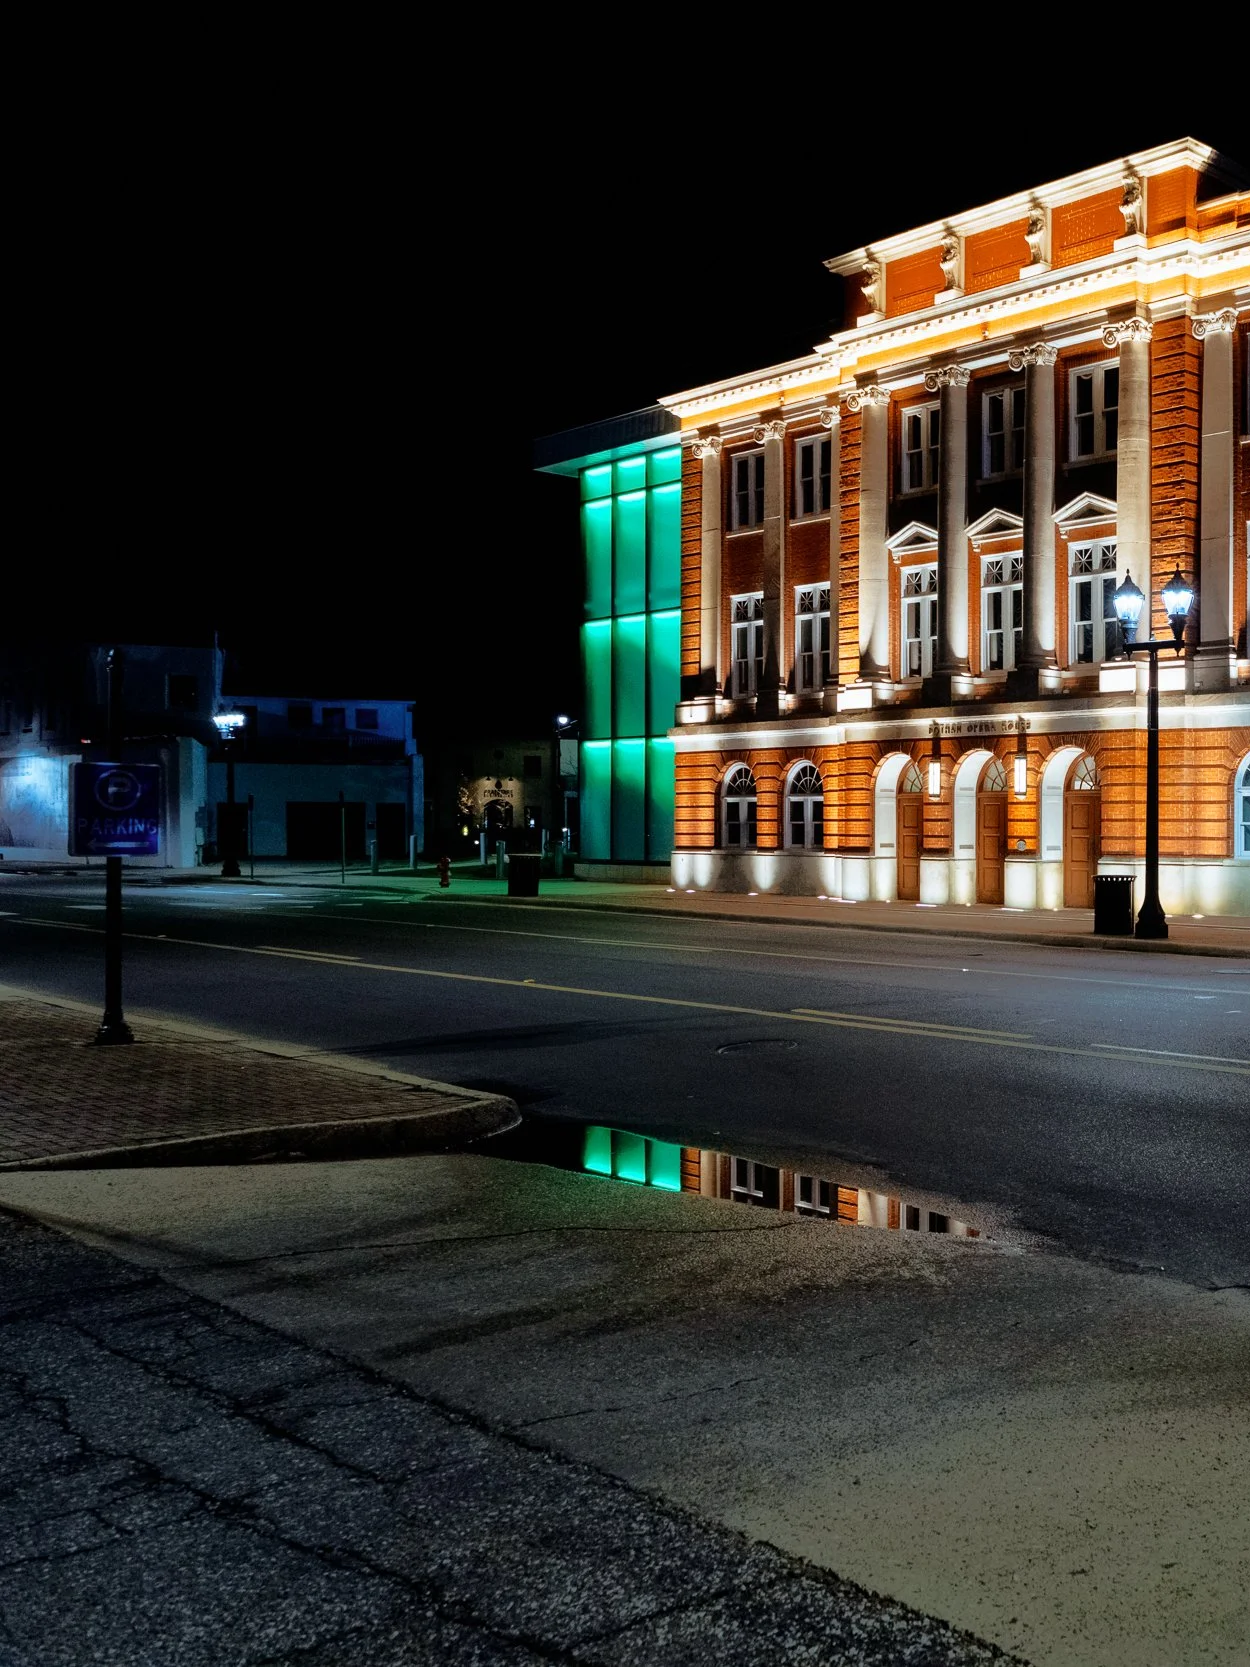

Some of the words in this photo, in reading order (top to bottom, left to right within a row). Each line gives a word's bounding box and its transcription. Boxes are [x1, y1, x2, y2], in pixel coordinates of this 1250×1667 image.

[928, 723, 962, 735] DOTHAN
[967, 723, 997, 733] OPERA
[1001, 721, 1031, 732] HOUSE
[107, 776, 132, 804] P
[77, 817, 157, 835] PARKING
